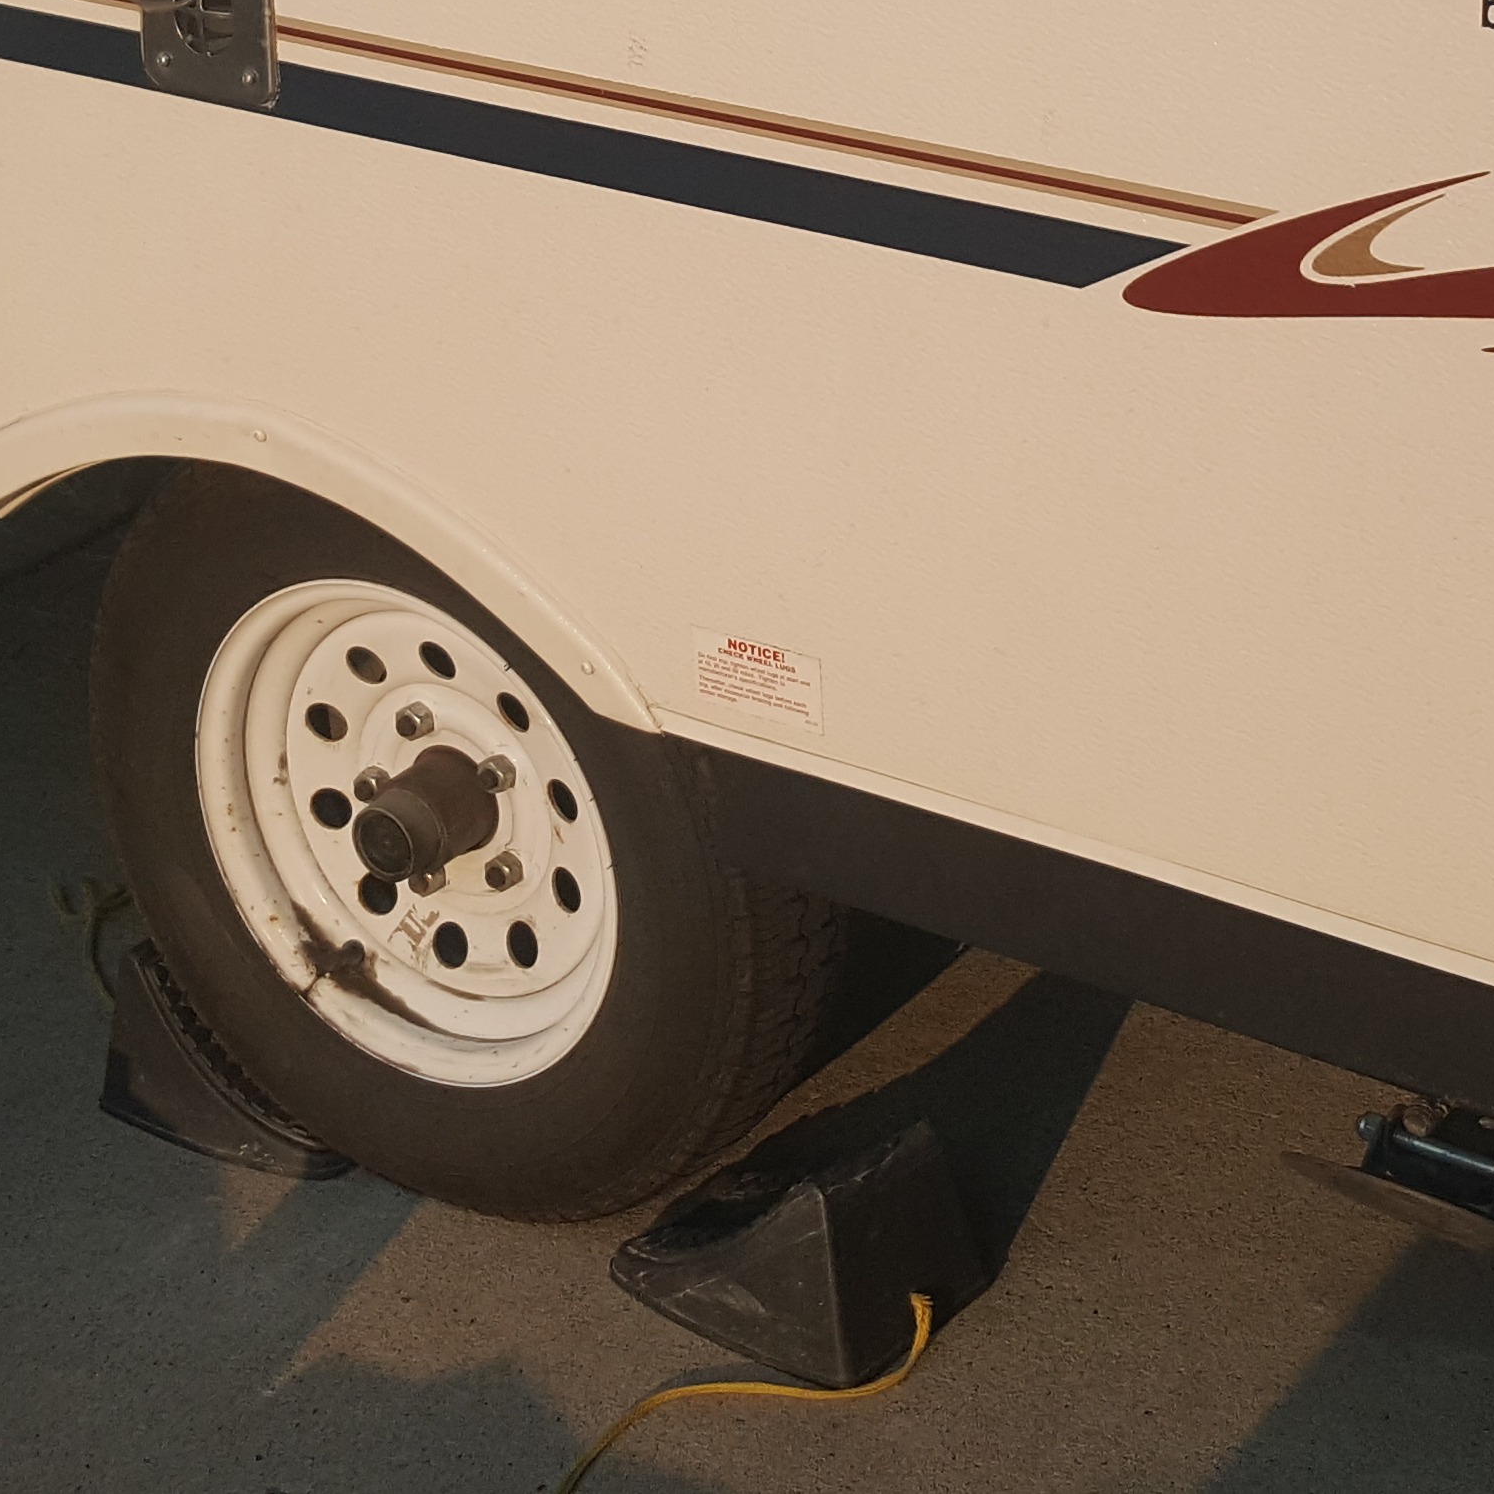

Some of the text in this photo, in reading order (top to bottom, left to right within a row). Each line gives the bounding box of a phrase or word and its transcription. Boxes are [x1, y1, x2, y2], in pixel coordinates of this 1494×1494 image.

[718, 647, 796, 673] CHECK WHEEL LUGS
[727, 638, 785, 663] NOTICE!
